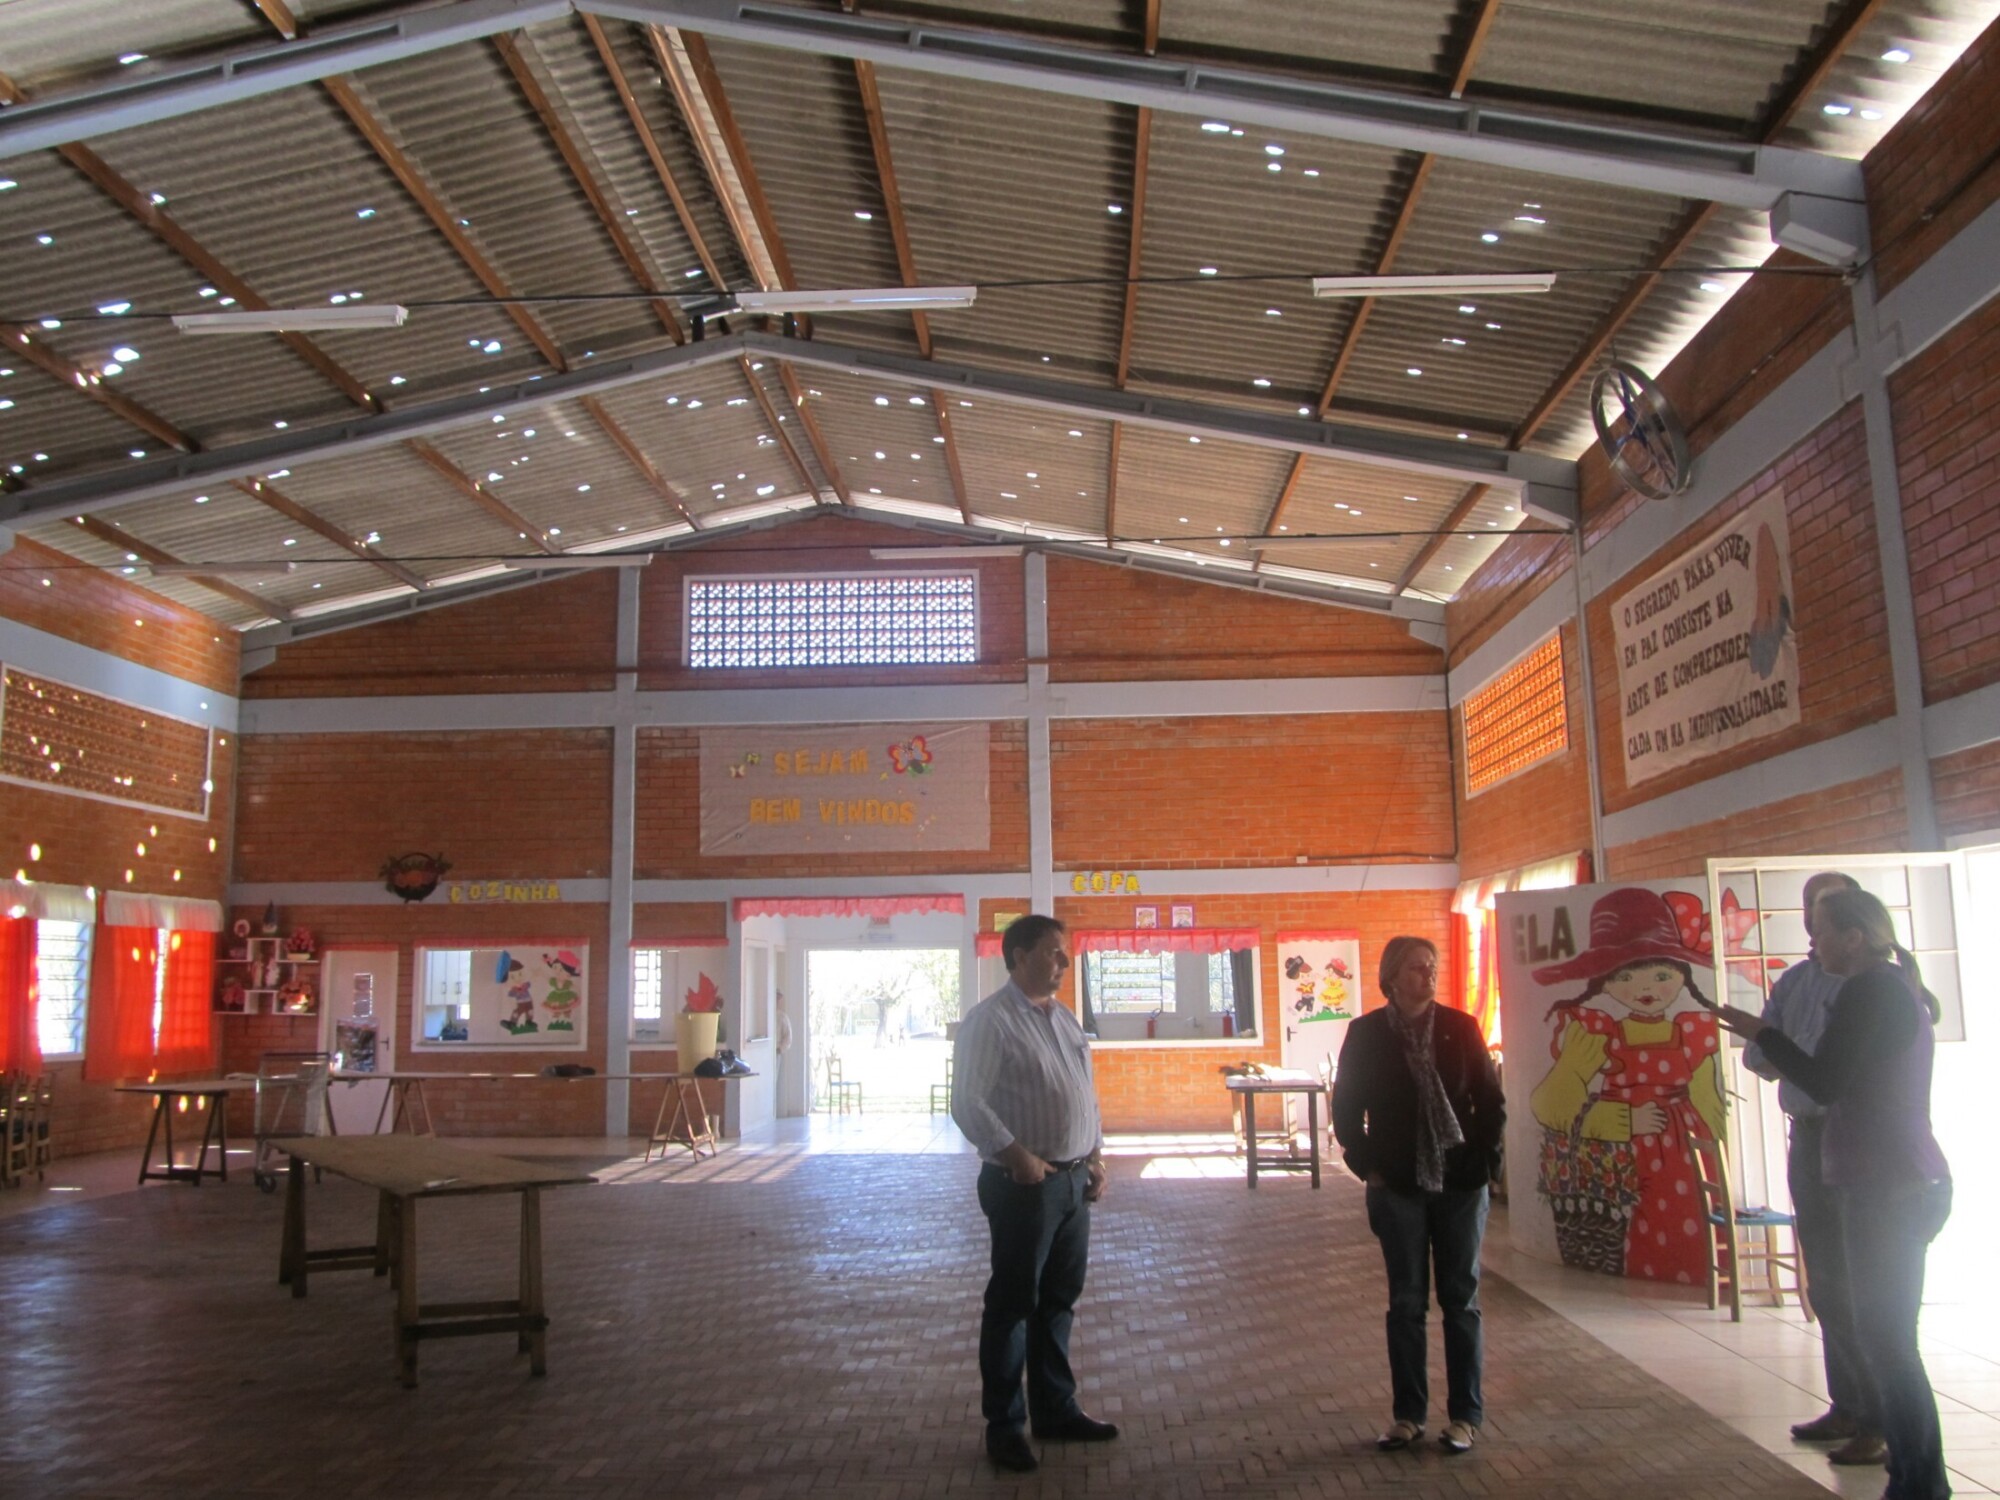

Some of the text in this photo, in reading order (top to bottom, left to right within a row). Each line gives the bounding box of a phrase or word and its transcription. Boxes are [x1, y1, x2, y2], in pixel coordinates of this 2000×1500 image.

[1624, 533, 1751, 628] O SEGREDO PARA VIVER
[1624, 588, 1734, 669] EM PAZ CONSISTE NA
[1626, 682, 1650, 717] ARTE
[1654, 671, 1668, 699] DE
[1628, 731, 1652, 761] CADA
[1655, 728, 1669, 752] UM
[1670, 722, 1684, 747] NA
[773, 748, 869, 776] SEJAM
[750, 798, 917, 825] BEM VINDOS
[450, 881, 560, 903] COZINHA
[1071, 871, 1141, 894] COPA
